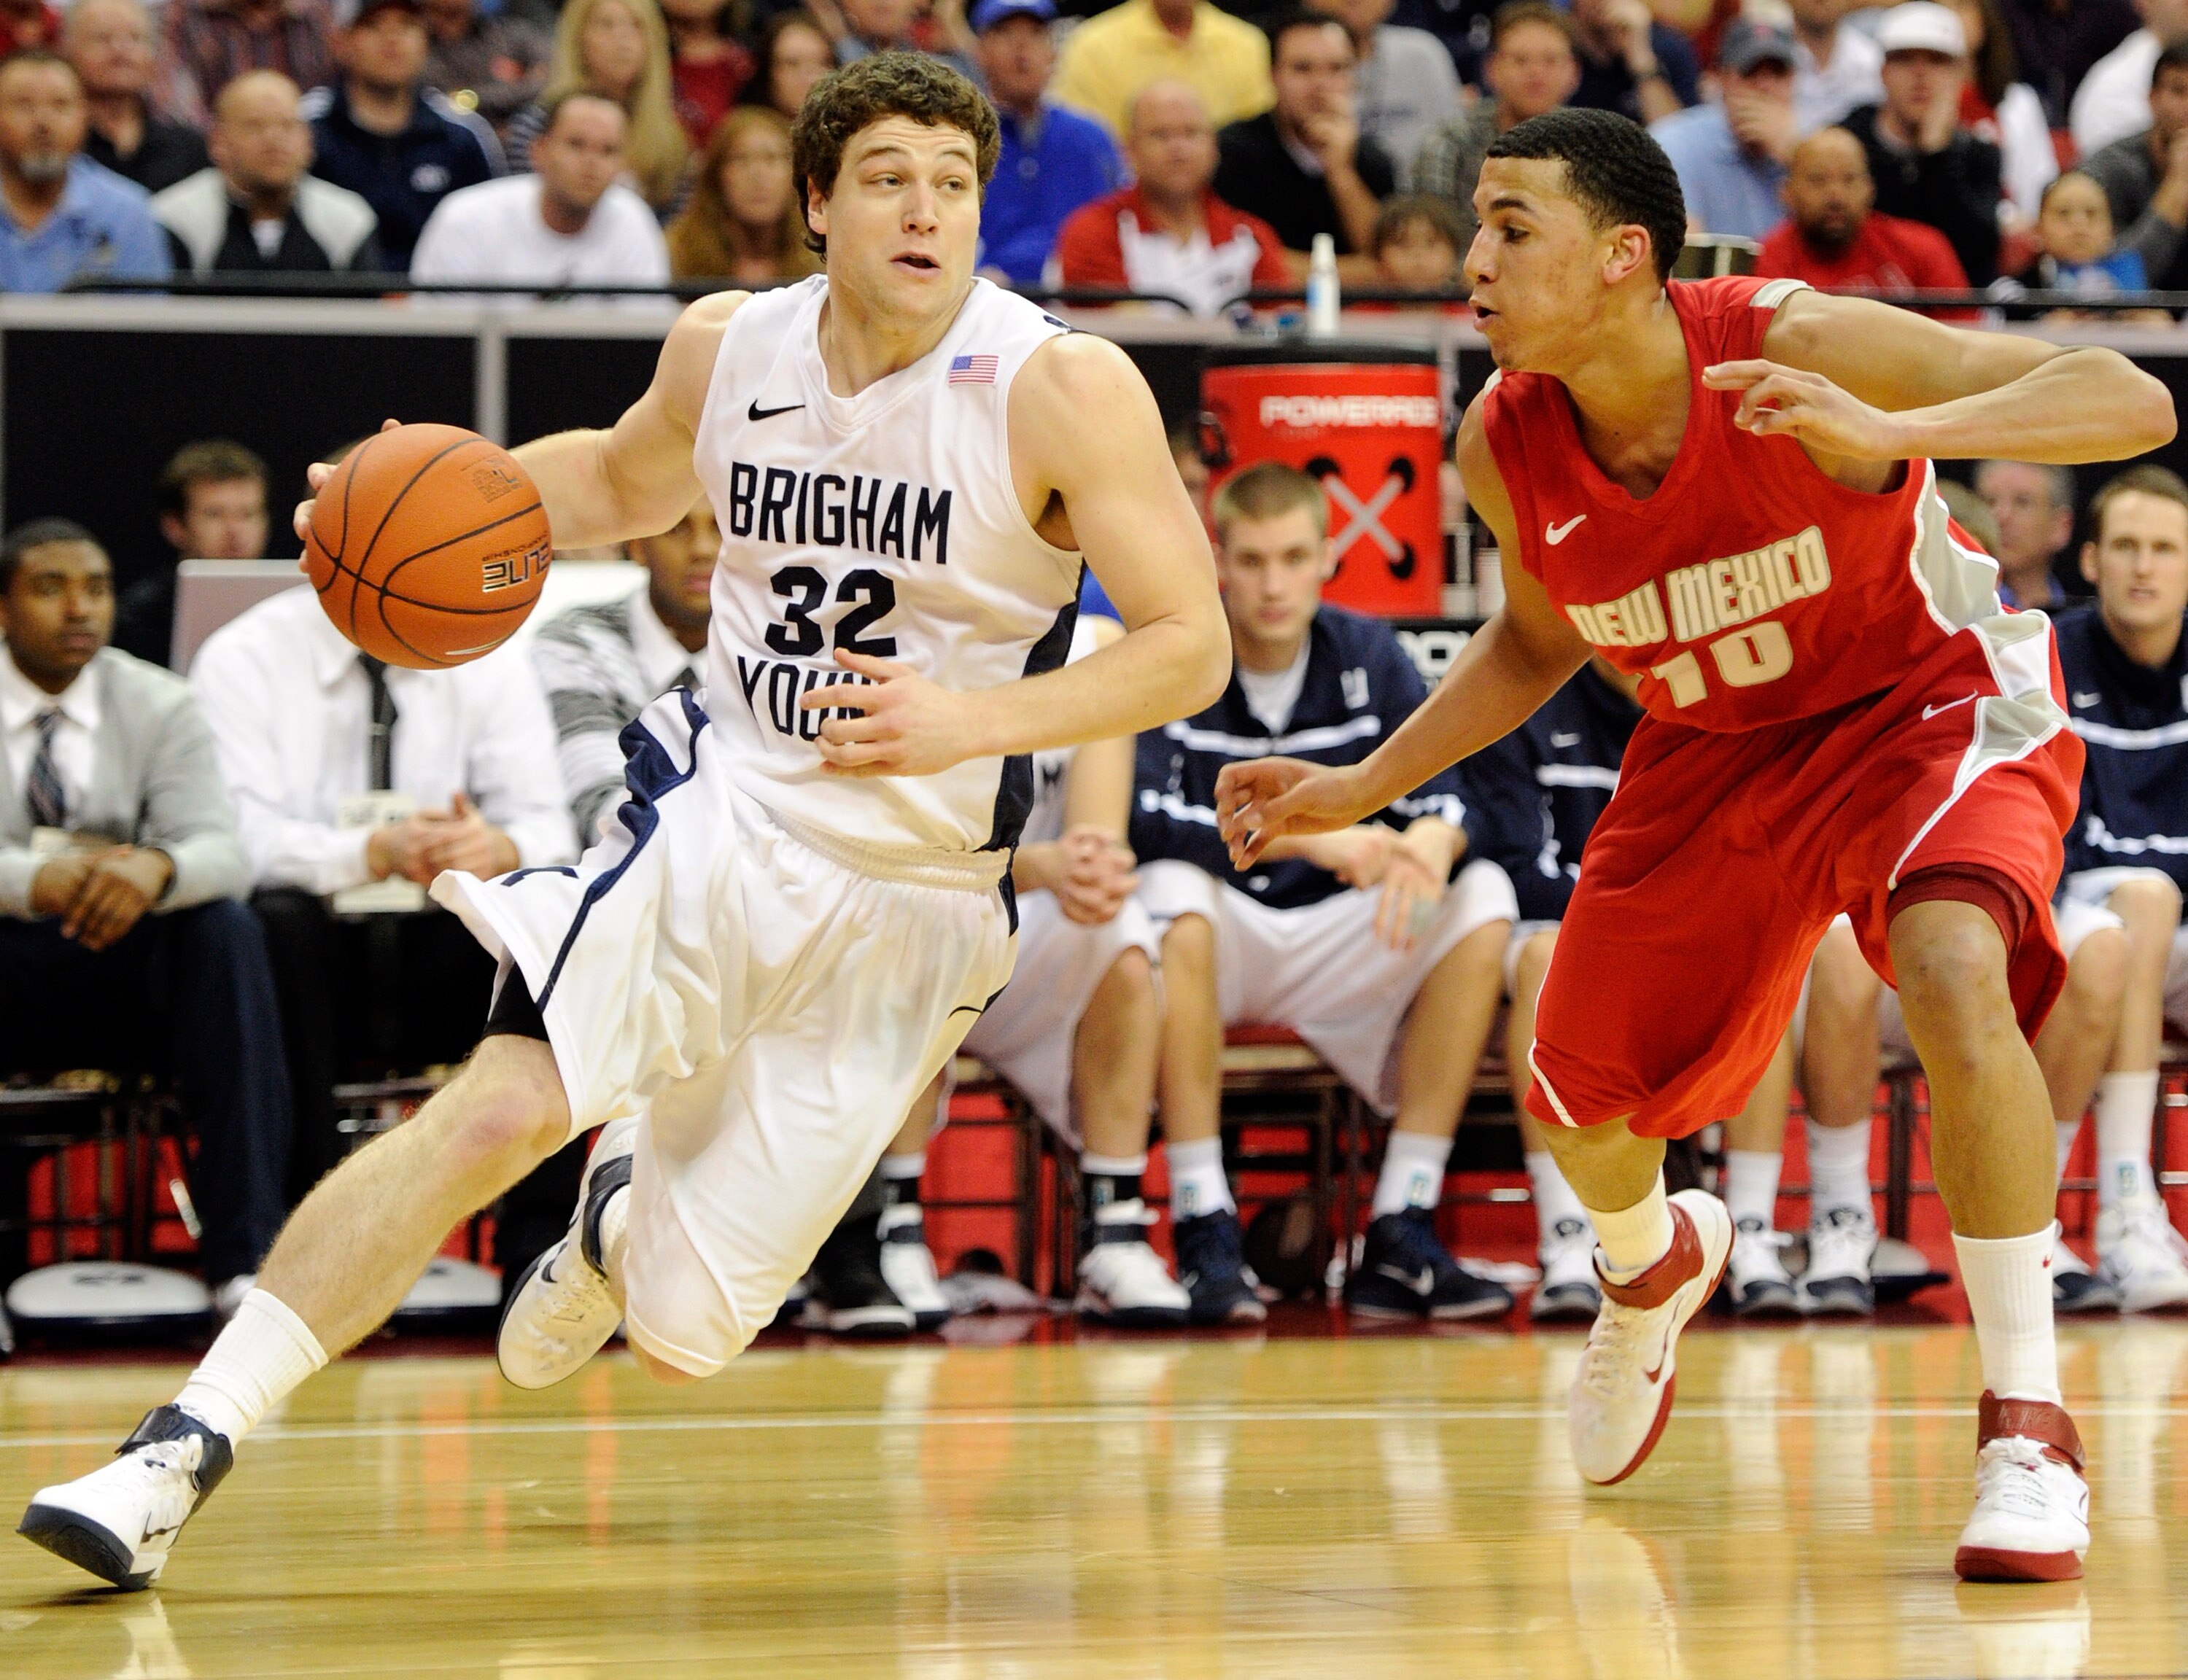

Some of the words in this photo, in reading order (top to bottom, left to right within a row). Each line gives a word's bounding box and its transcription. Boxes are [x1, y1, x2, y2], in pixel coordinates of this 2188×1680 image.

[730, 461, 953, 564] BRIGHAM
[764, 566, 897, 658] 32
[1564, 579, 1668, 647] NEW
[1666, 525, 1831, 643] MEXICO
[1650, 621, 1793, 709] 10
